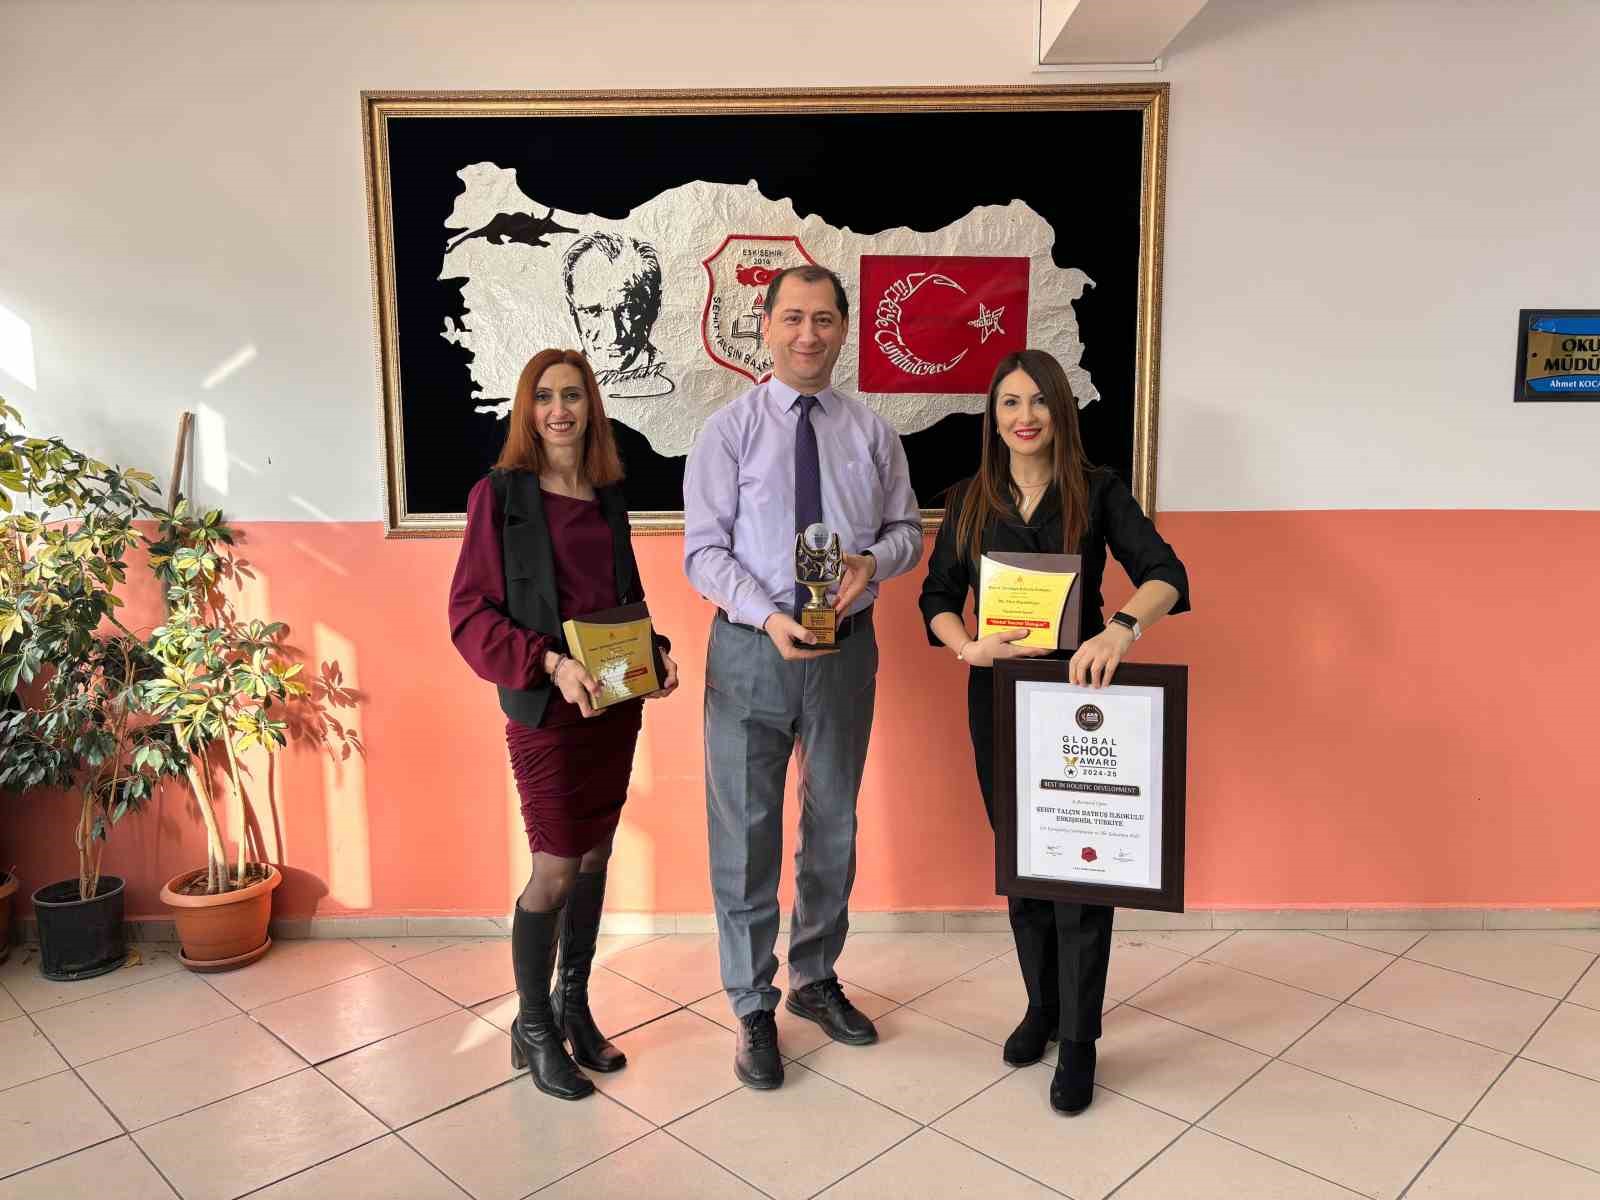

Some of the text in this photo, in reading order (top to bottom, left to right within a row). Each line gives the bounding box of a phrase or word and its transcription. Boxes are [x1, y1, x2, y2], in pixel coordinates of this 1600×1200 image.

[1551, 379, 1577, 388] Ahmet
[1062, 735, 1117, 746] GLOBAL
[1062, 744, 1117, 758] SCHOOL
[1079, 757, 1117, 767] AWARD
[1082, 768, 1117, 778] 2024-25
[1043, 781, 1057, 789] BEST
[1066, 782, 1092, 791] HOLISTIC
[1093, 785, 1137, 793] DEVELOPMENT
